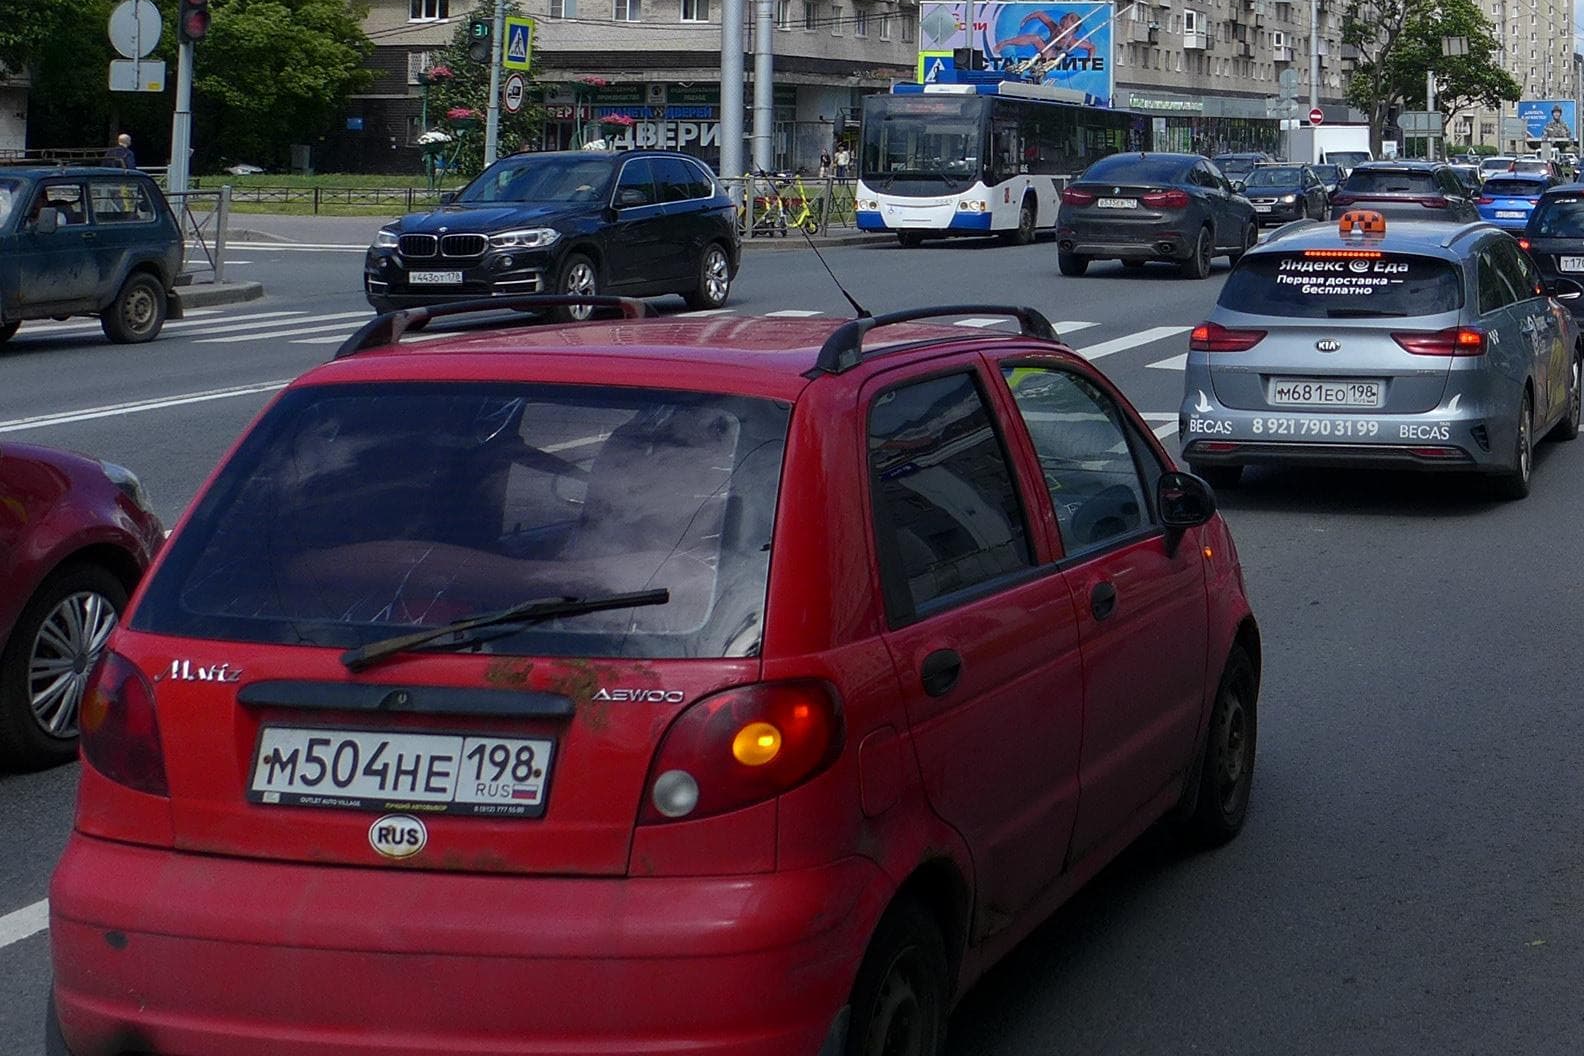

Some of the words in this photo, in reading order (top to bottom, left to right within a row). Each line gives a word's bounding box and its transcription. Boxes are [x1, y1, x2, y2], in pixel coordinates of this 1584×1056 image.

[474, 24, 488, 36] 31
[1279, 258, 1345, 272] Яндекс
[1374, 260, 1409, 274] Еда
[1277, 274, 1324, 286] Первая
[1326, 276, 1388, 286] доставка
[1301, 285, 1373, 295] бесплатно
[1318, 341, 1338, 350] KIA
[1279, 384, 1346, 402] М681ЕО
[1349, 384, 1373, 398] 198
[1189, 419, 1232, 435] BECAS
[1252, 418, 1264, 434] 8
[1267, 418, 1295, 435] 921
[1300, 419, 1331, 435] 790
[1334, 420, 1352, 436] 31
[1356, 420, 1379, 436] 99
[1399, 424, 1450, 440] BECAS
[154, 659, 243, 682] Matiz
[266, 737, 453, 794] М504НЕ
[466, 743, 535, 783] 198
[475, 782, 511, 799] RUS
[377, 826, 420, 846] RUS
